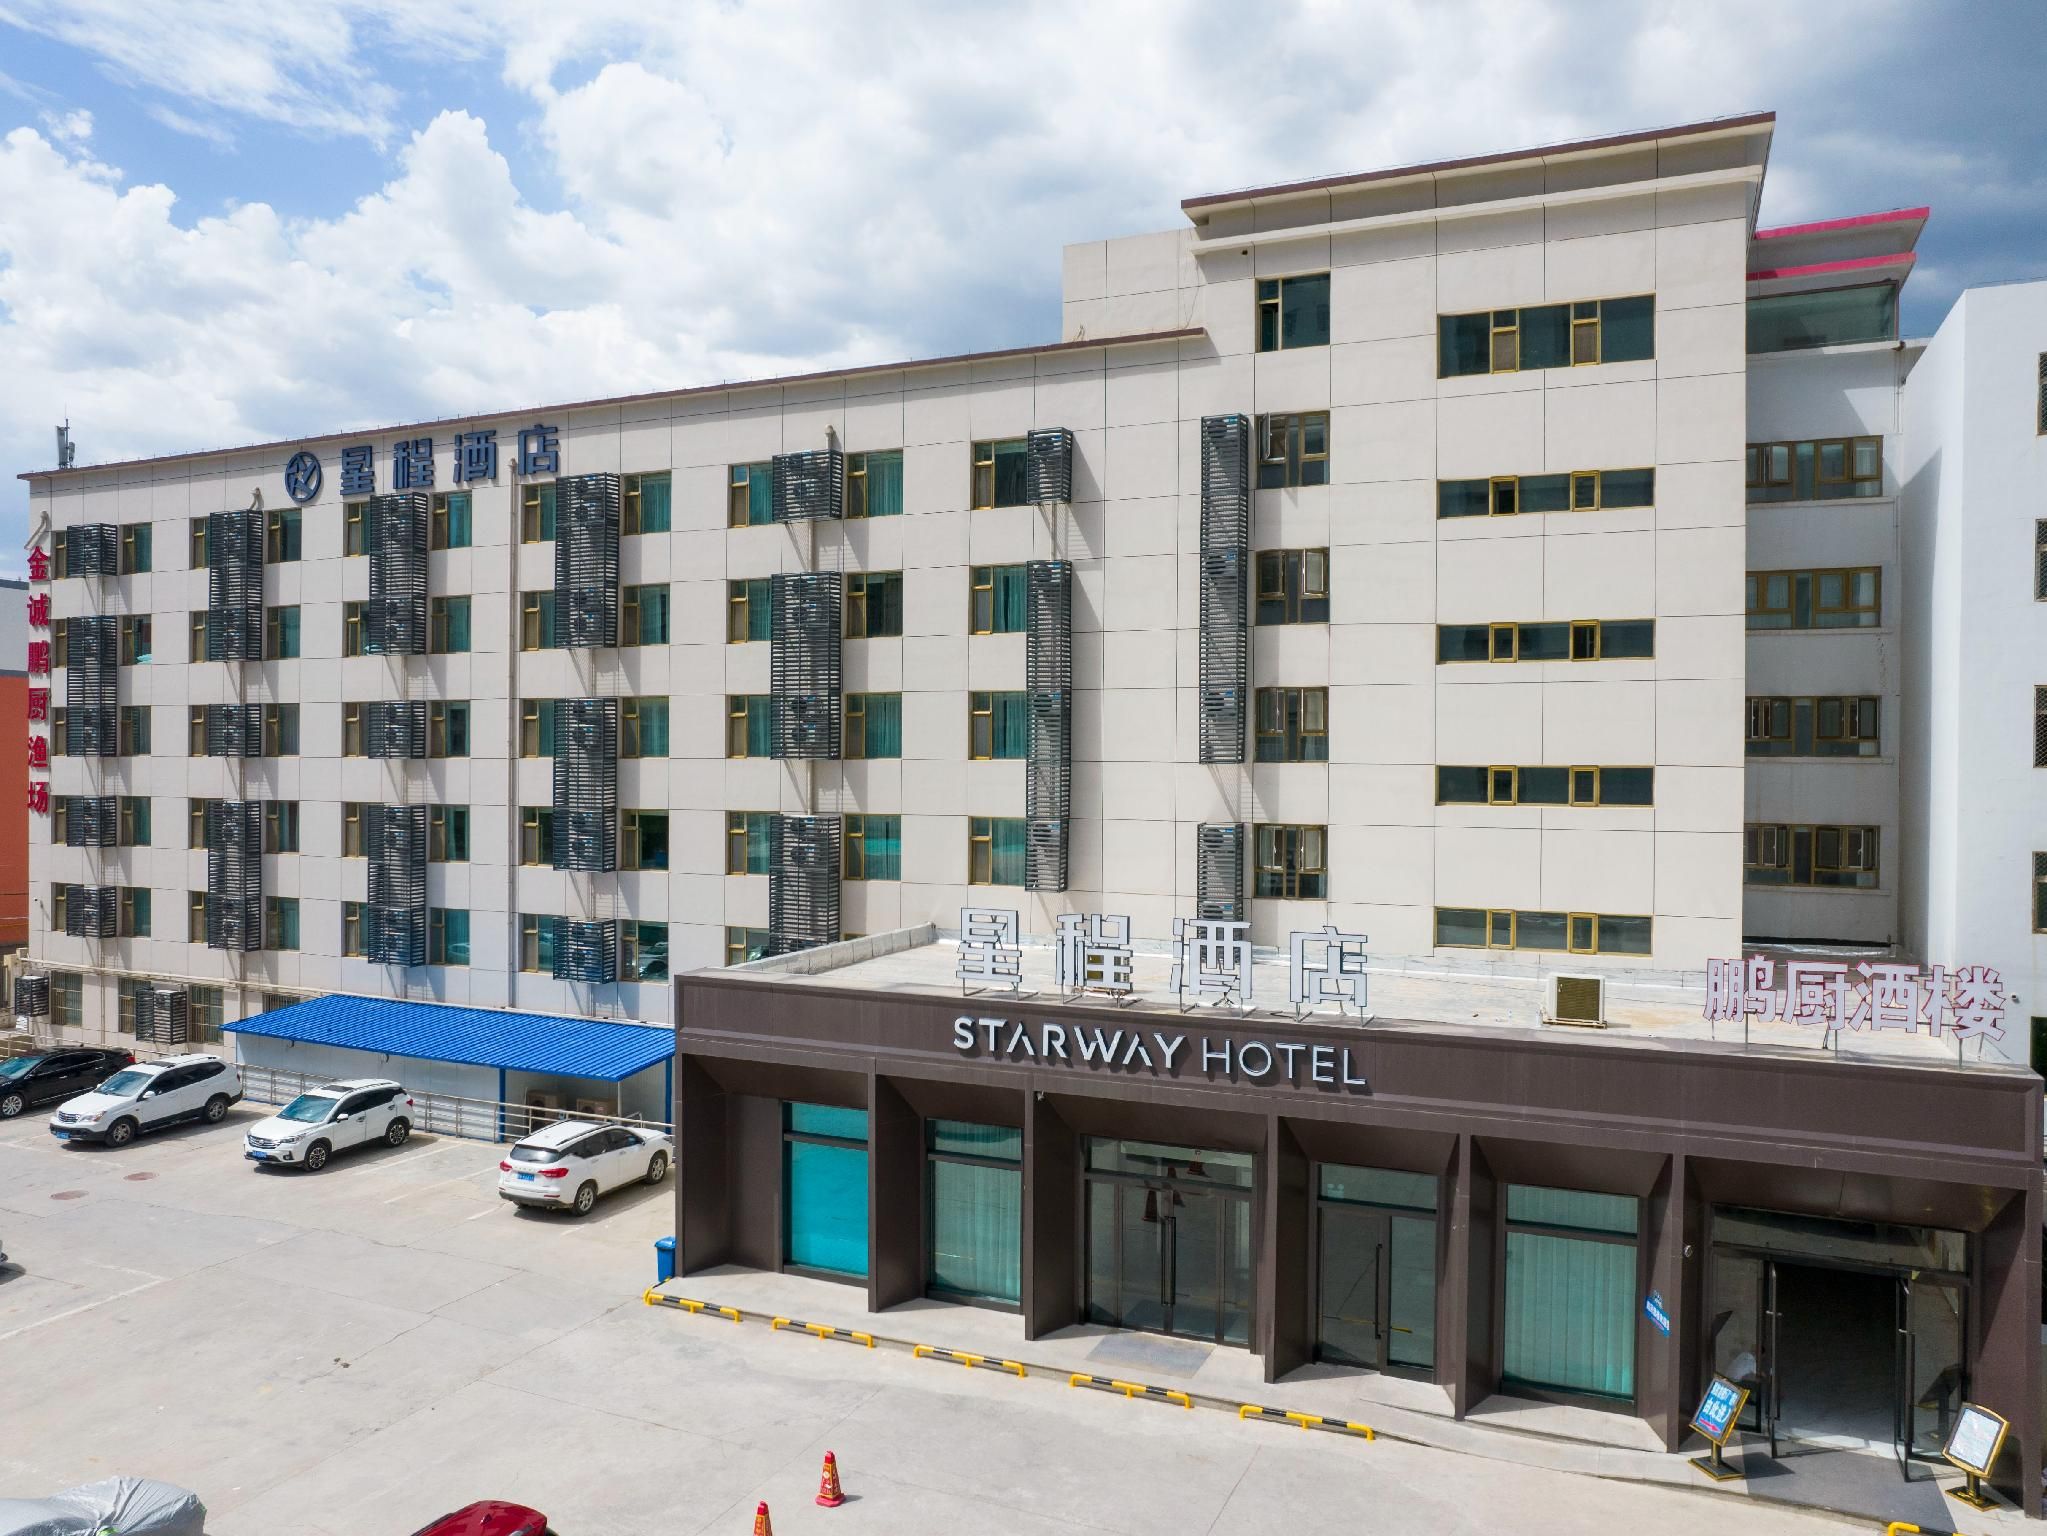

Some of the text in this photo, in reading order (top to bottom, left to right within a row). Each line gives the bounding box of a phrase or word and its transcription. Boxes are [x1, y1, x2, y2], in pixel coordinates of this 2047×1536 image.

[340, 424, 559, 496] 星程酒店
[955, 907, 1368, 1008] 星程酒店
[1702, 954, 2006, 1042] 鹏厨酒楼
[954, 1015, 1367, 1085] STARWAY HOTEL
